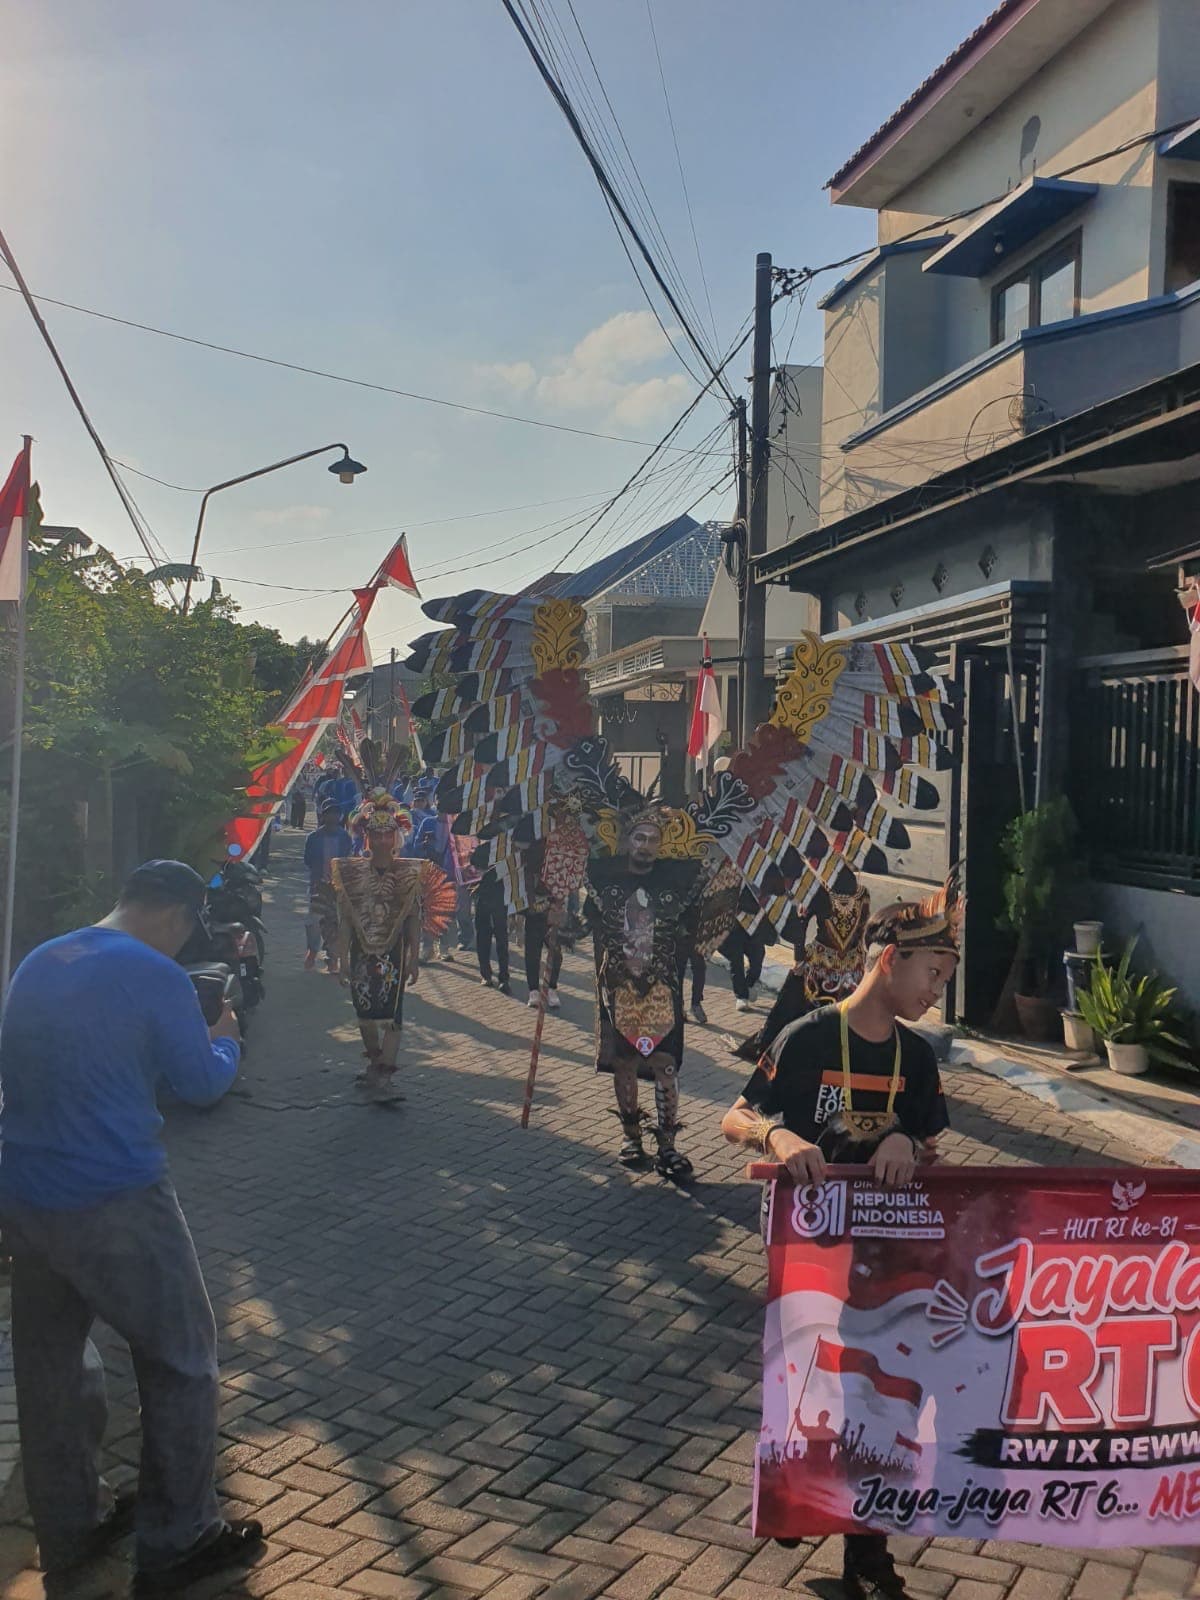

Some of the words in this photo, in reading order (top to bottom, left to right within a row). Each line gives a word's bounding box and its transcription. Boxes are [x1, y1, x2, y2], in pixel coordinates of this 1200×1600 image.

[791, 1180, 848, 1238] 81
[853, 1193, 930, 1207] REPUBLIK
[852, 1209, 945, 1225] INDONESIA
[1064, 1217, 1103, 1240] HUT
[1105, 1216, 1129, 1238] RI
[1131, 1215, 1179, 1237] ke-81
[1000, 1437, 1059, 1463] RW
[1066, 1438, 1101, 1463] IX
[853, 1475, 1032, 1524] Jaya-jaya
[1040, 1479, 1098, 1518] RT
[1098, 1479, 1140, 1516] 6...
